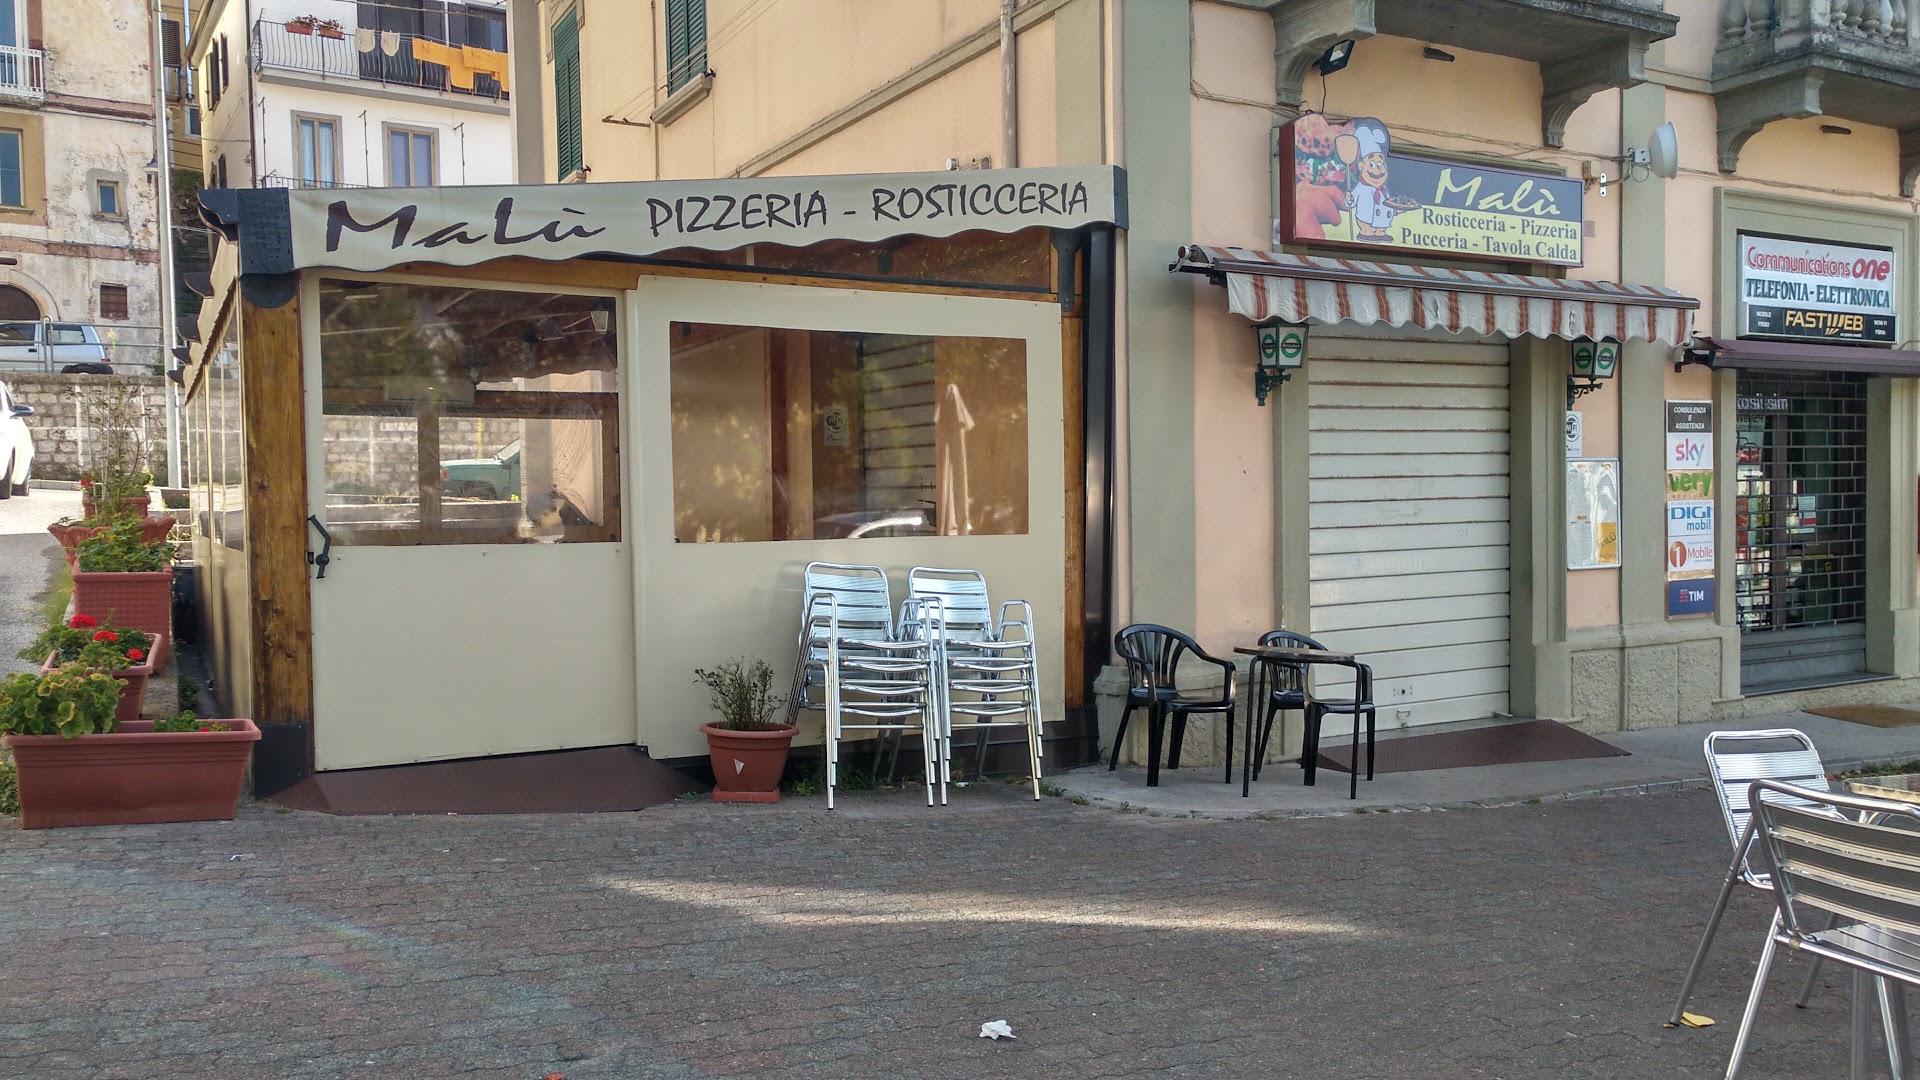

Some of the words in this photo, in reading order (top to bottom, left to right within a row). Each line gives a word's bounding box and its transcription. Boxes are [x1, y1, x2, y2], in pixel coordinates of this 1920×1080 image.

[1434, 168, 1561, 216] Malù
[646, 190, 827, 238] PIZZERIA
[872, 181, 1088, 222] ROSTICCERIA
[1422, 207, 1506, 232] Rosticceria
[1520, 218, 1577, 240] Pizzeria
[1400, 227, 1468, 250] Pucceria
[1482, 235, 1531, 256] Tavola
[1535, 241, 1577, 260] Calda
[1747, 245, 1851, 277] Communications
[1852, 258, 1891, 281] one
[1816, 284, 1890, 308] ELETTRONICA
[1756, 310, 1772, 318] MOBILE
[1785, 310, 1864, 332] FASTWEB
[1673, 406, 1706, 414] CONSULENZA
[1675, 422, 1705, 430] ASSISTENZA
[1675, 437, 1705, 467] sky
[1667, 472, 1713, 497] very
[1670, 505, 1711, 520] DIGI
[1686, 518, 1712, 531] mobil
[1687, 545, 1713, 559] Mobile
[1688, 590, 1704, 602] TIM
